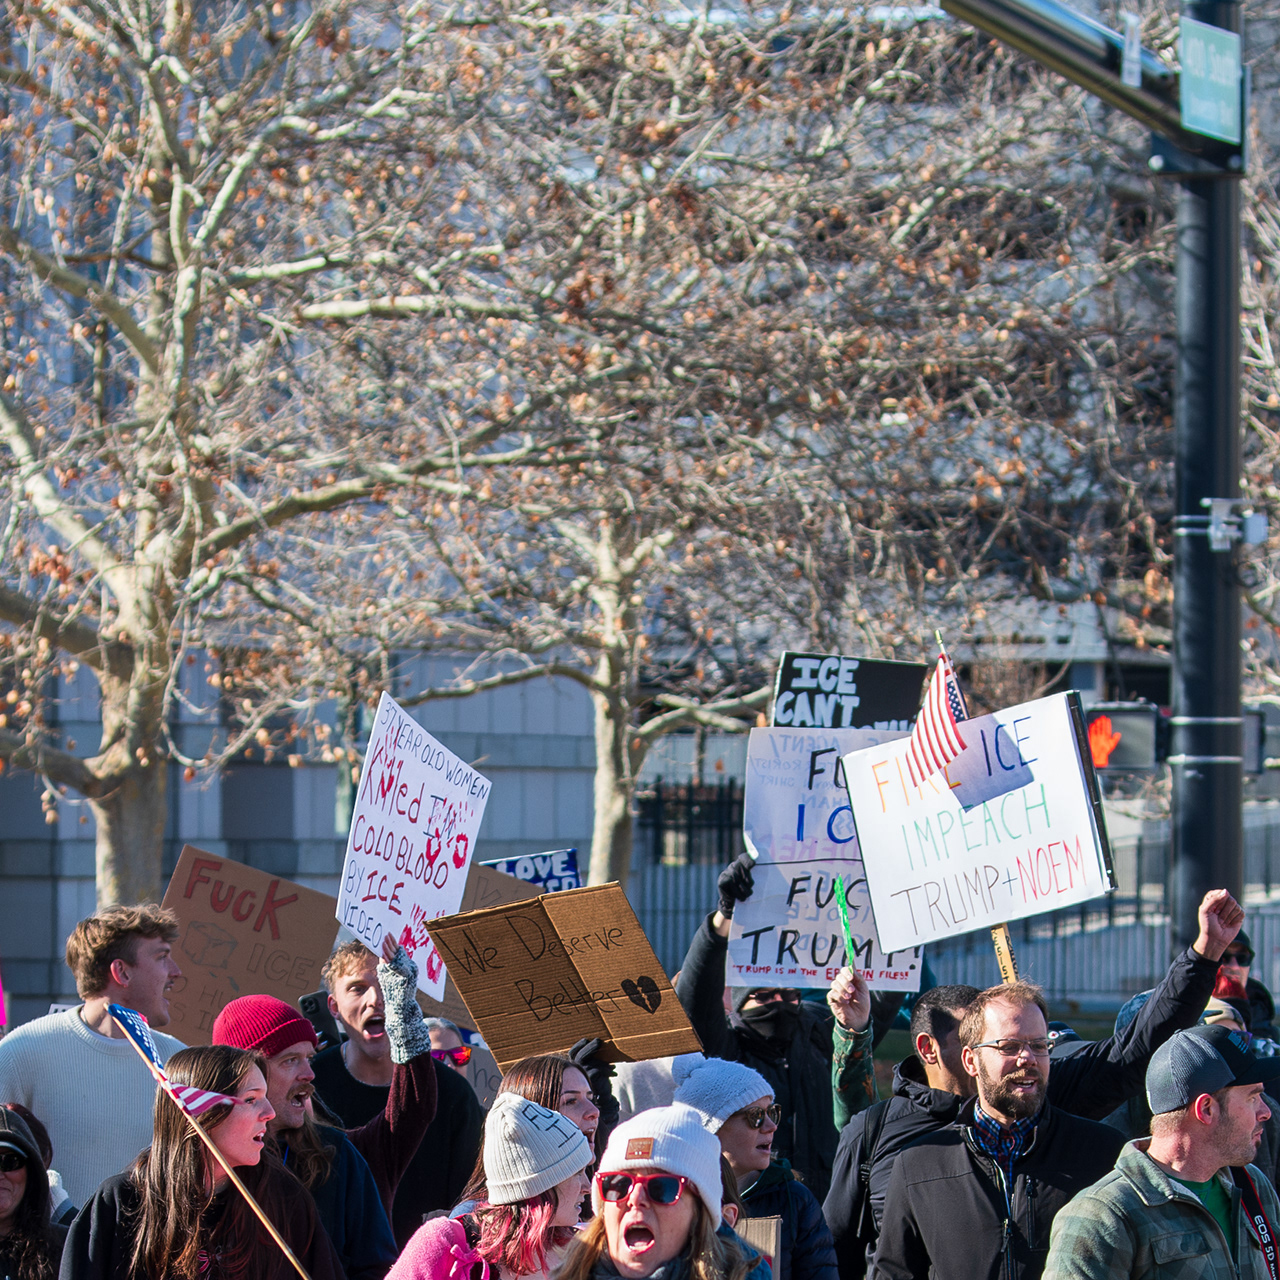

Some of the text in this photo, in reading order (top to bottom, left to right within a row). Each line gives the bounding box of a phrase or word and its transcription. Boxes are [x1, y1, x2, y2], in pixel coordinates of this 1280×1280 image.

[791, 657, 859, 694] ICE
[381, 701, 489, 800] 37 YEAR OLD WOMEN
[980, 716, 1038, 776] ICE
[352, 814, 449, 890] COLD BLOOD
[901, 784, 1051, 871] IMPEACH
[346, 859, 405, 915] BY ICE
[496, 852, 576, 881] LOVE
[343, 899, 383, 948] VIDEO
[434, 914, 624, 976] We Deserve
[246, 943, 315, 990] ICE
[774, 966, 785, 975] IS
[800, 968, 818, 977] THE
[515, 976, 622, 1022] Better
[1254, 1214, 1271, 1245] EOS
[1265, 1246, 1276, 1262] 5D
